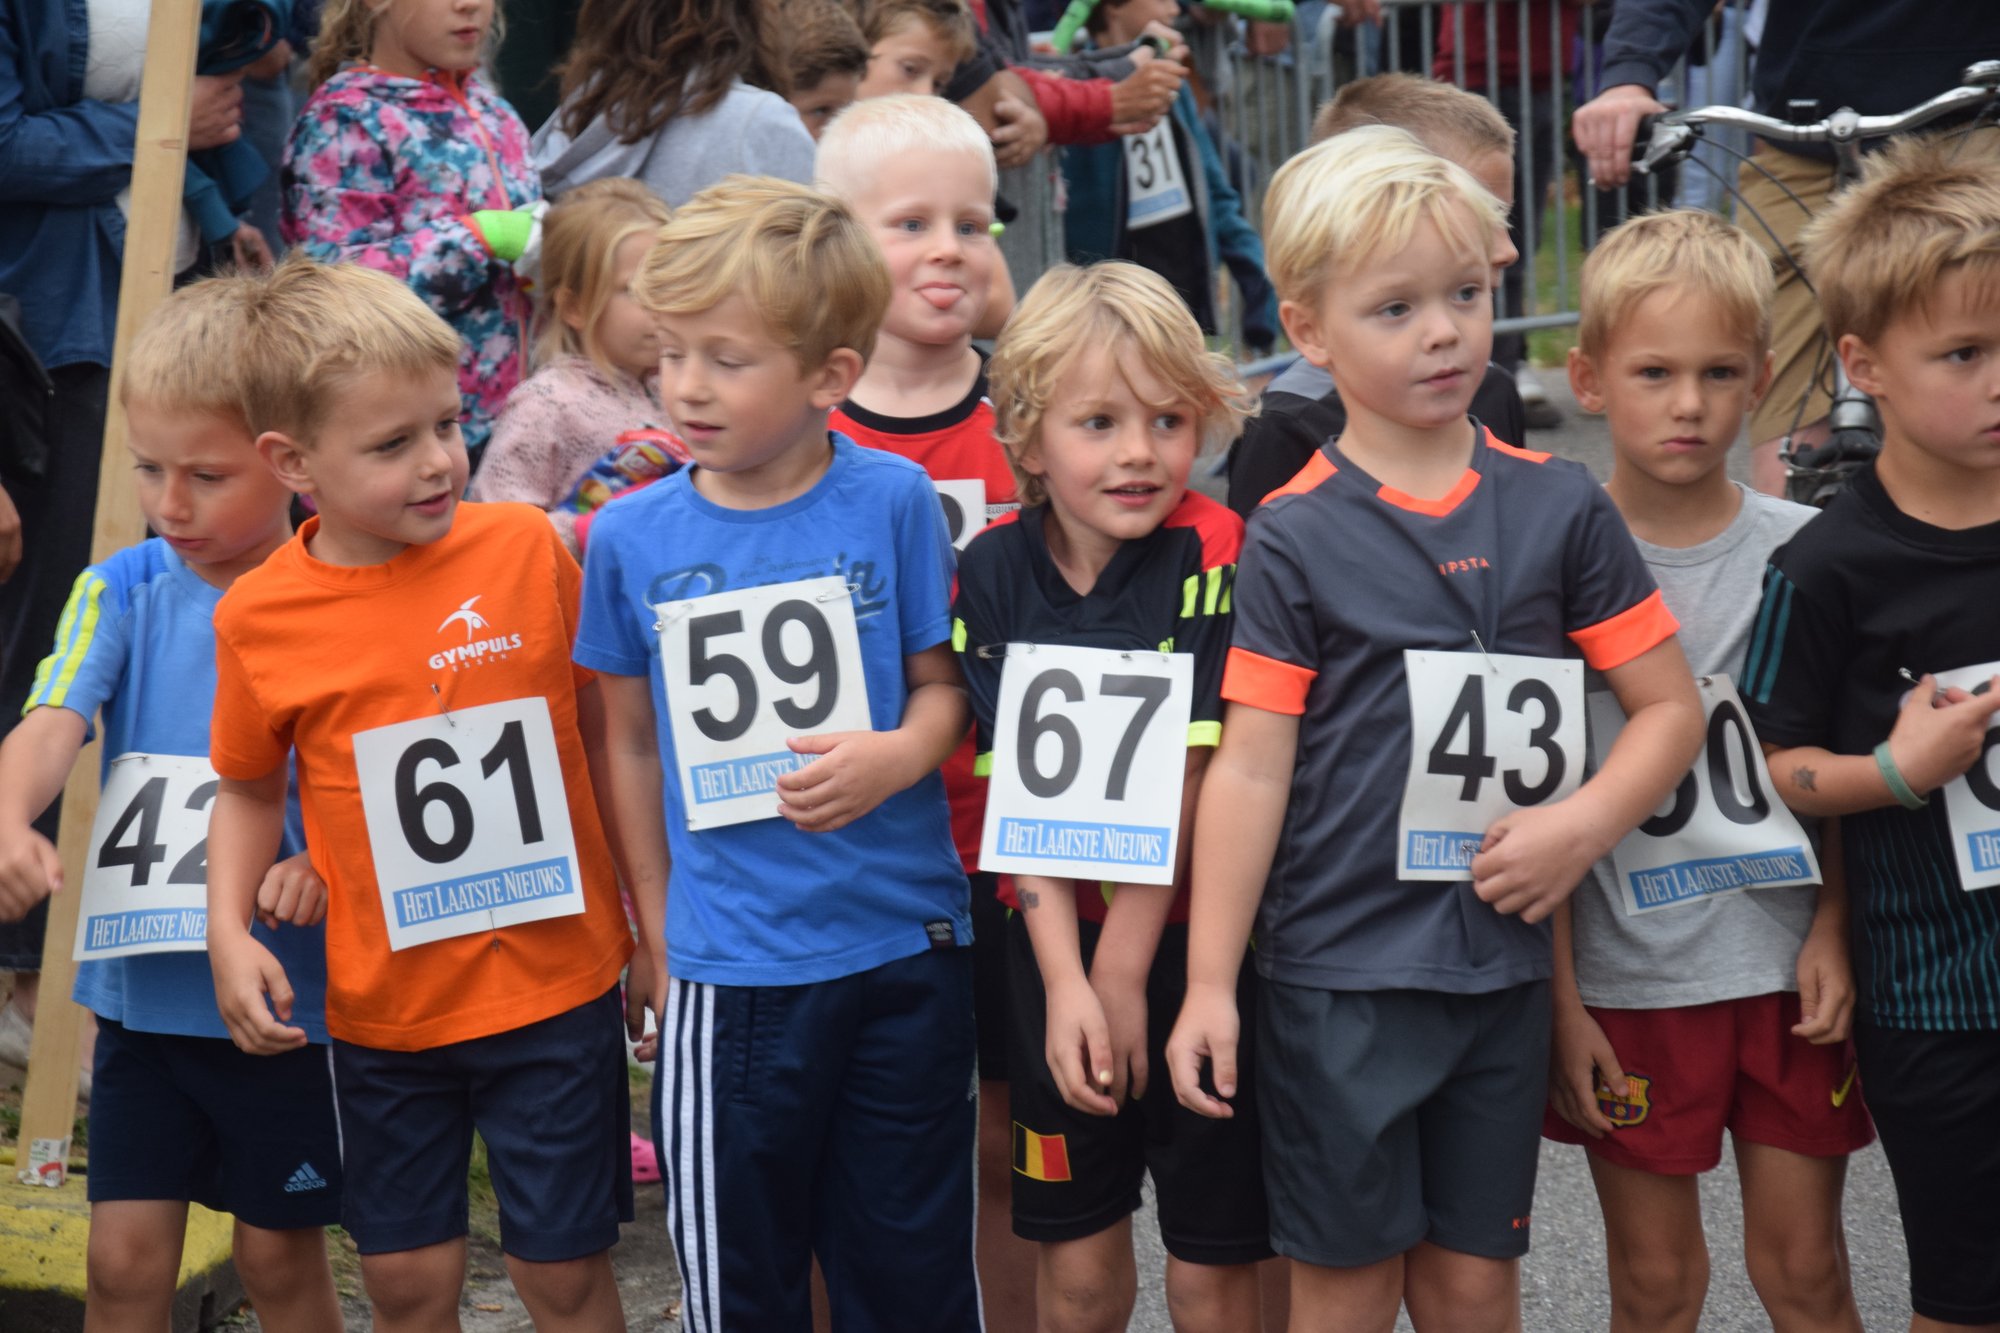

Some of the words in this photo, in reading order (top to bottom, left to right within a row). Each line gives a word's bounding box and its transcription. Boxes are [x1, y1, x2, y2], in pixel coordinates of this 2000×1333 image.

[1132, 132, 1173, 189] 31
[428, 633, 522, 670] GYMPULS
[688, 599, 839, 742] 59
[1017, 669, 1171, 801] 67
[1426, 674, 1567, 807] 43
[395, 720, 545, 865] 61
[696, 768, 729, 800] HET
[97, 776, 219, 887] 42
[1004, 821, 1036, 854] HET
[1035, 823, 1100, 859] LAATSTE
[1101, 826, 1163, 864] NIEUWS
[1412, 833, 1440, 866] HET
[401, 891, 437, 923] HET
[434, 878, 504, 915] LAATSTE
[502, 865, 565, 902] NIEUWS
[1637, 873, 1674, 905] HET
[1670, 867, 1740, 897] LAATSTE
[1736, 854, 1803, 882] NIEUWS
[91, 918, 120, 947] HET
[119, 913, 178, 944] LAATSTE
[283, 1178, 327, 1193] adidas
